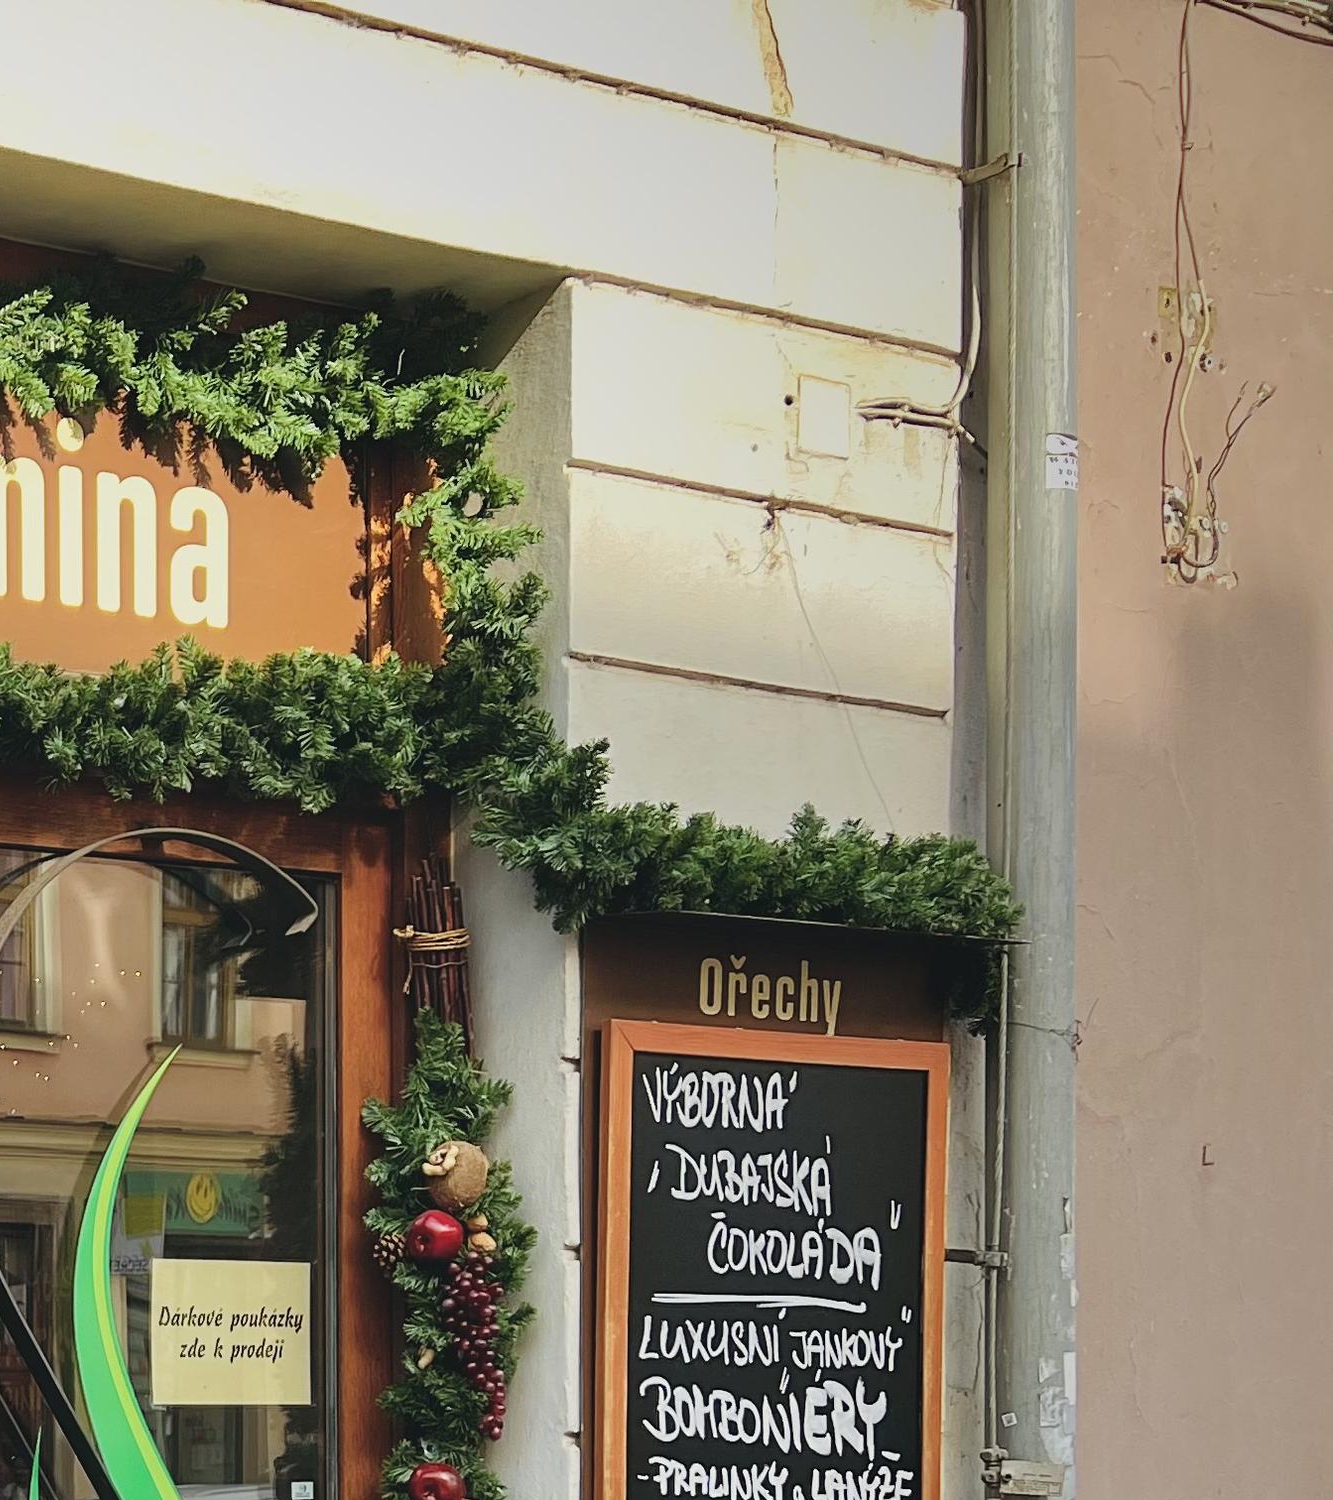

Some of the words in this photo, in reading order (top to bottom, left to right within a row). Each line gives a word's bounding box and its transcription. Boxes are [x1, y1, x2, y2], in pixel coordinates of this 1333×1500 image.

[700, 955, 841, 1036] Ořechy
[642, 1062, 798, 1133] VÝBORNÁ
[158, 1305, 223, 1328] Dárkové
[230, 1306, 304, 1334] poukázky
[638, 1308, 787, 1366] LUXUSNÍ
[179, 1337, 206, 1358] zde
[214, 1337, 223, 1358] k
[230, 1338, 285, 1363] prodeji
